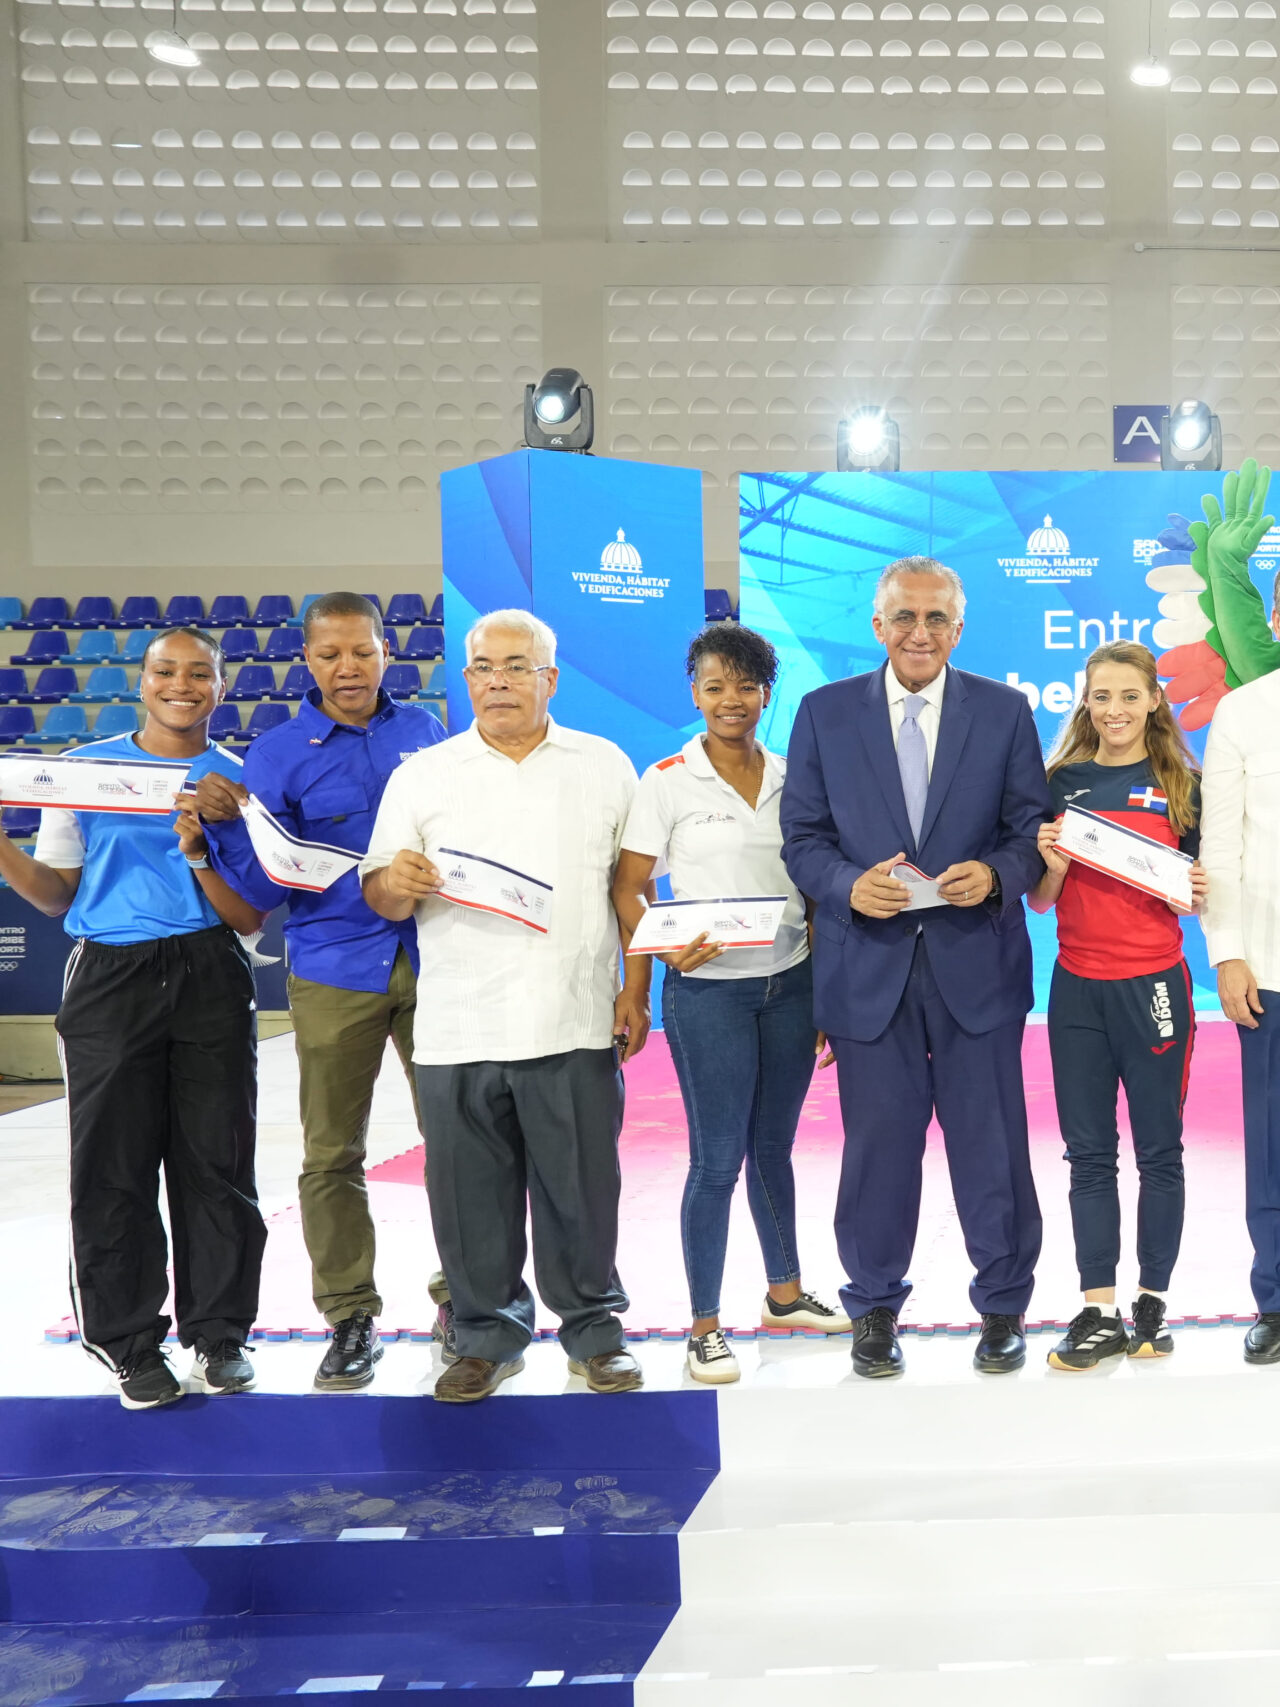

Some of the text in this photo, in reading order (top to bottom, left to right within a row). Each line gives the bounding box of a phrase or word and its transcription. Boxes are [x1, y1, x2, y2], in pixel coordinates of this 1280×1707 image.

[1122, 416, 1161, 445] A
[997, 557, 1052, 568] VIVIENDA,
[571, 571, 671, 588] VIVIENDA, HÁBITAT
[1004, 568, 1093, 577] Y EDIFICACIONES
[579, 583, 665, 598] Y EDIFICACIONES
[1044, 610, 1151, 650] Entr
[1154, 981, 1172, 1020] DOM
